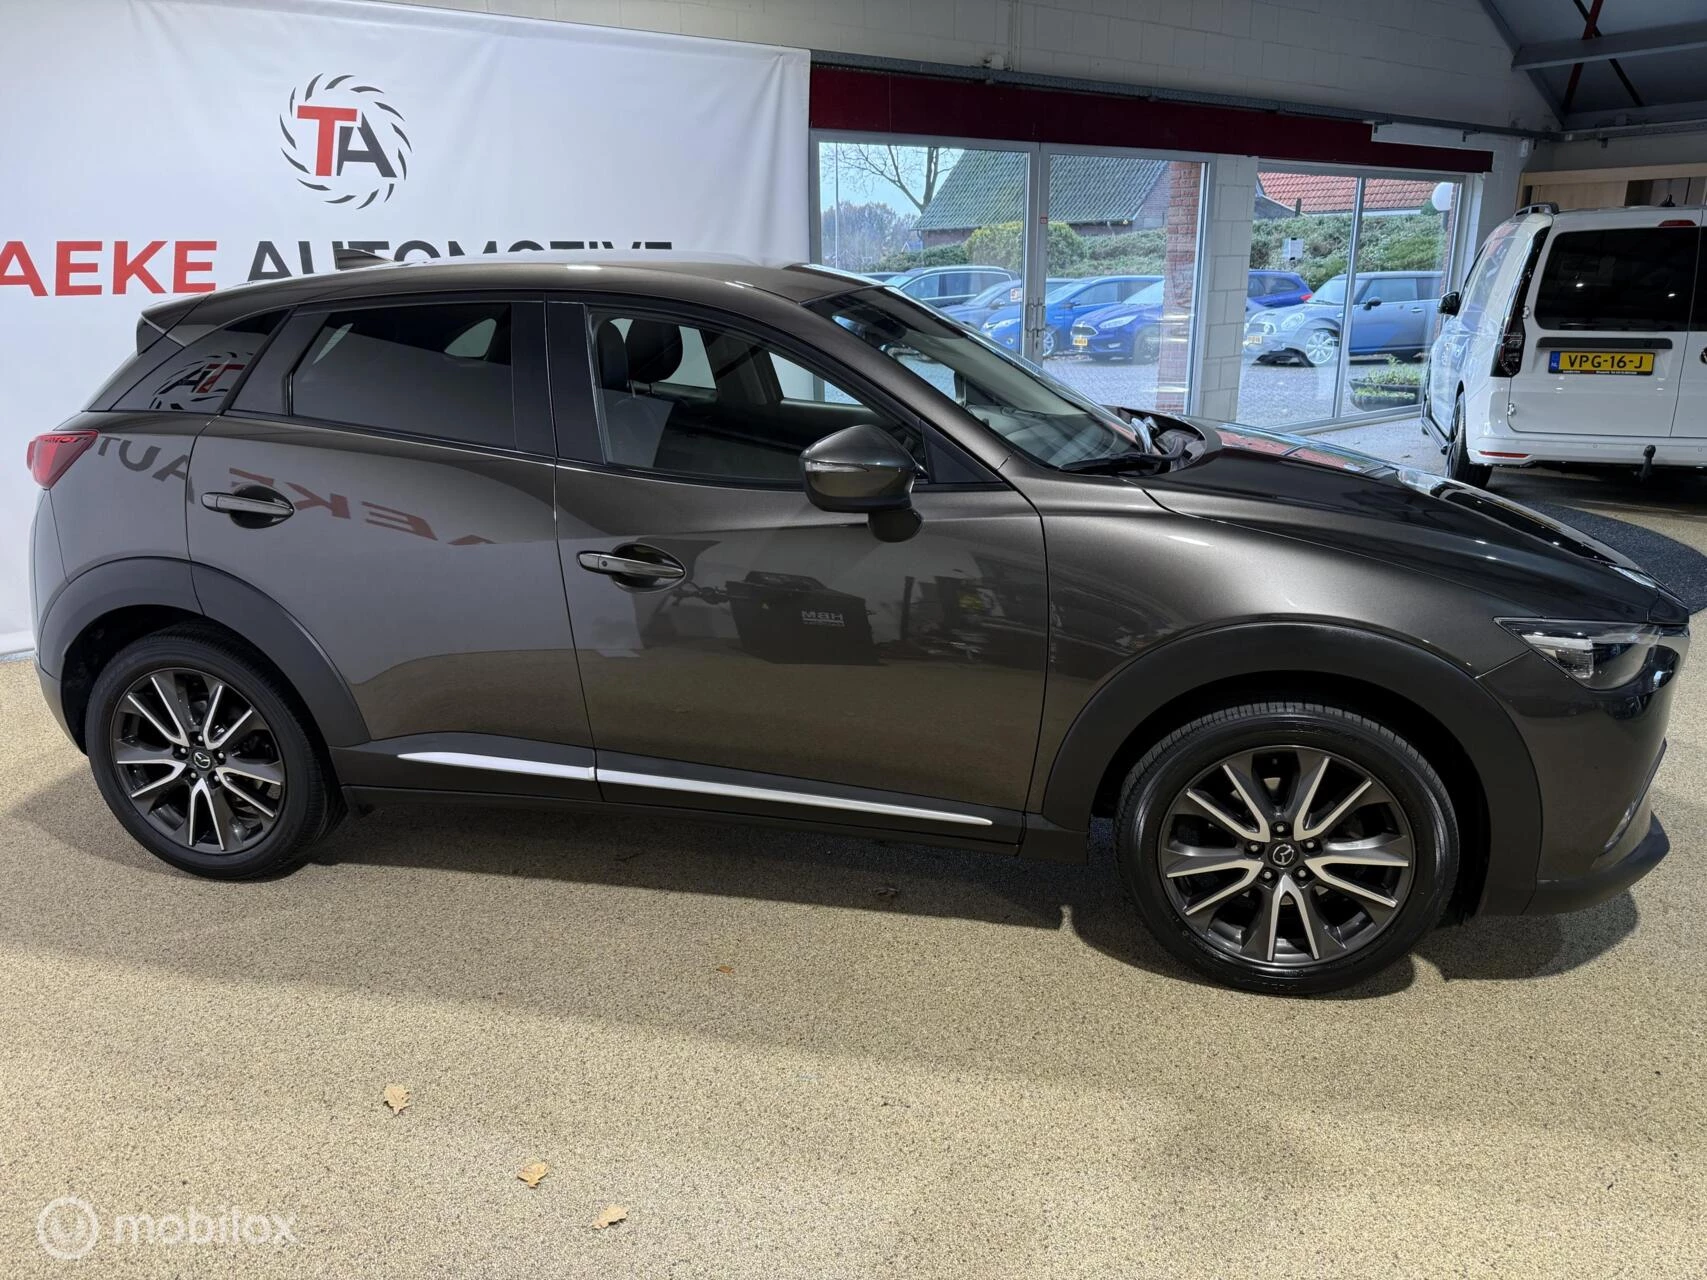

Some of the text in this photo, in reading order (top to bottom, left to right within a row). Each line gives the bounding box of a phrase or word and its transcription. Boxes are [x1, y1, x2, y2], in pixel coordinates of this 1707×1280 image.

[297, 105, 398, 178] TA
[0, 241, 217, 296] AEKE
[1568, 354, 1644, 369] VPG-16-J
